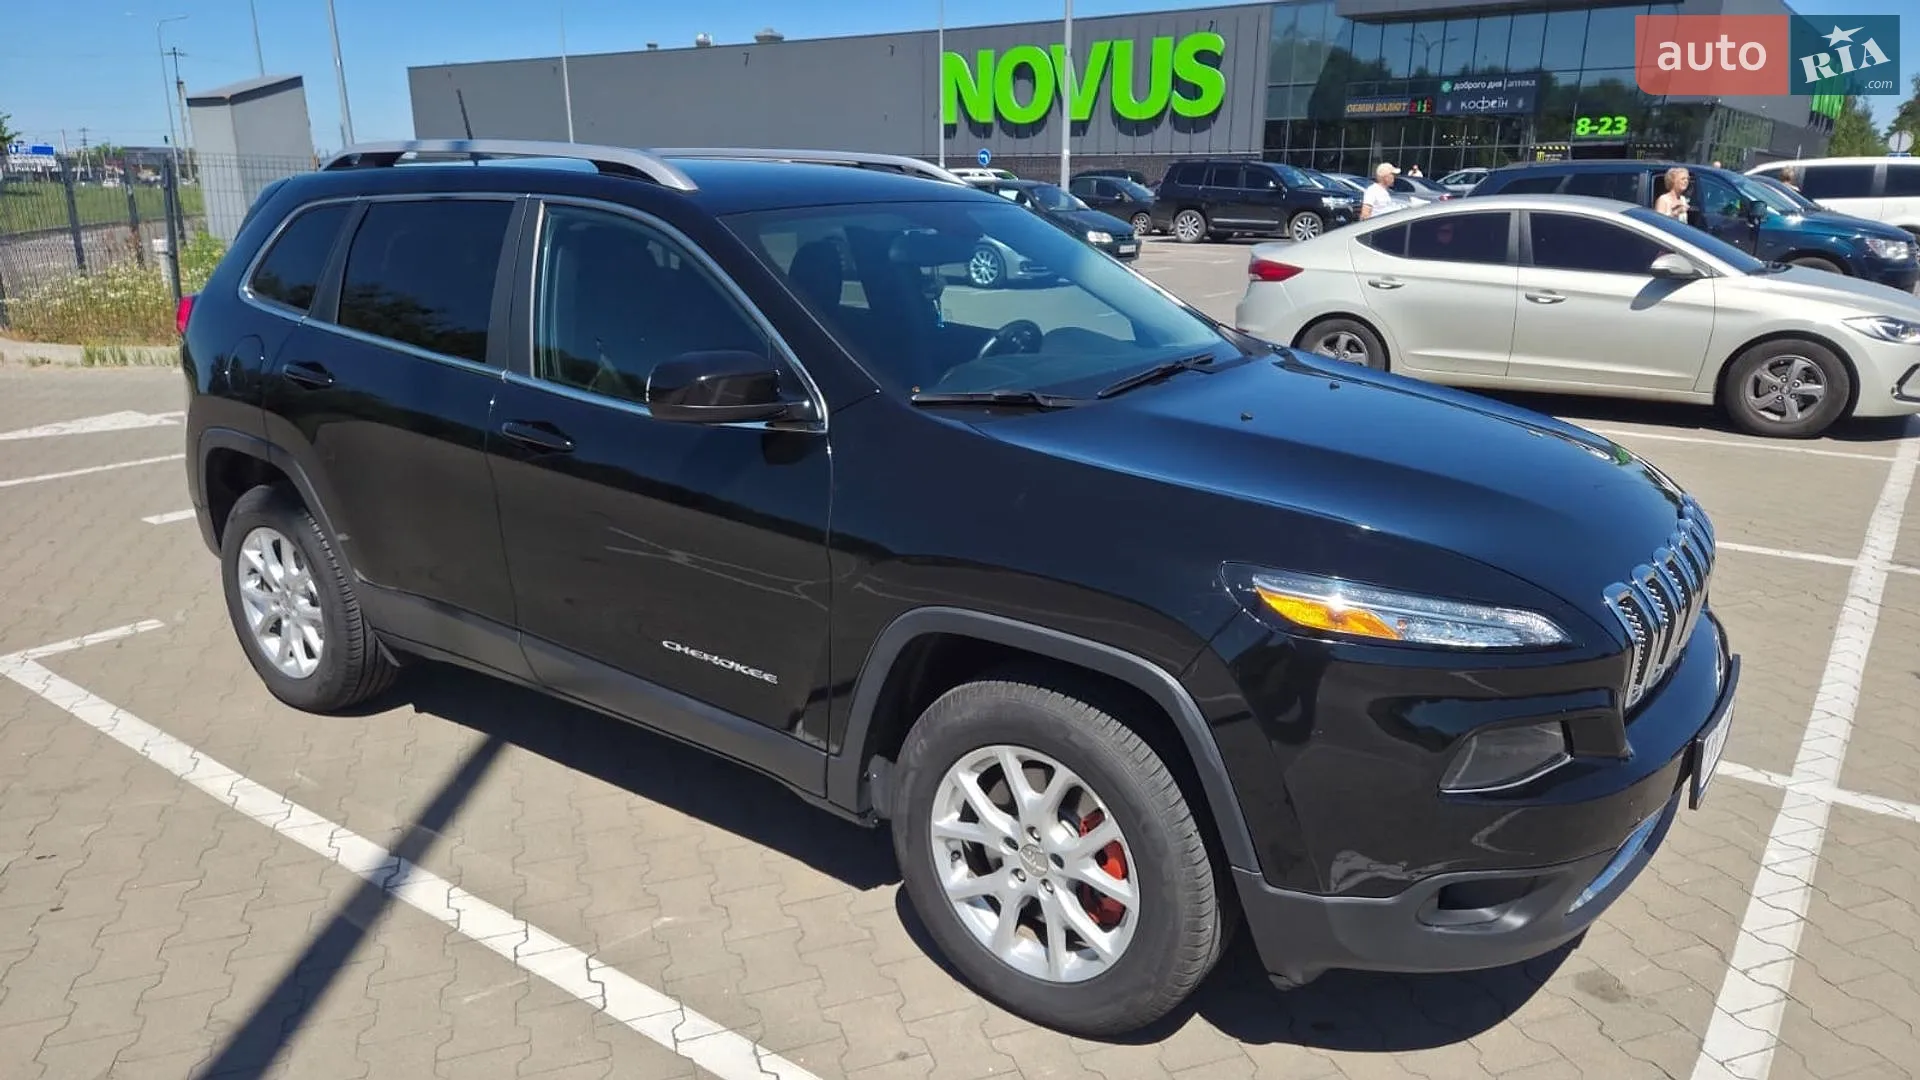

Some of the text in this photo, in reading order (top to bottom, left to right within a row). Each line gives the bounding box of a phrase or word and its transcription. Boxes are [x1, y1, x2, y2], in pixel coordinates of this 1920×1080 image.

[943, 32, 1226, 124] NOVUS
[1453, 81, 1487, 92] доброго
[1575, 116, 1628, 136] 8-23
[662, 640, 778, 684] CHEROKEE
